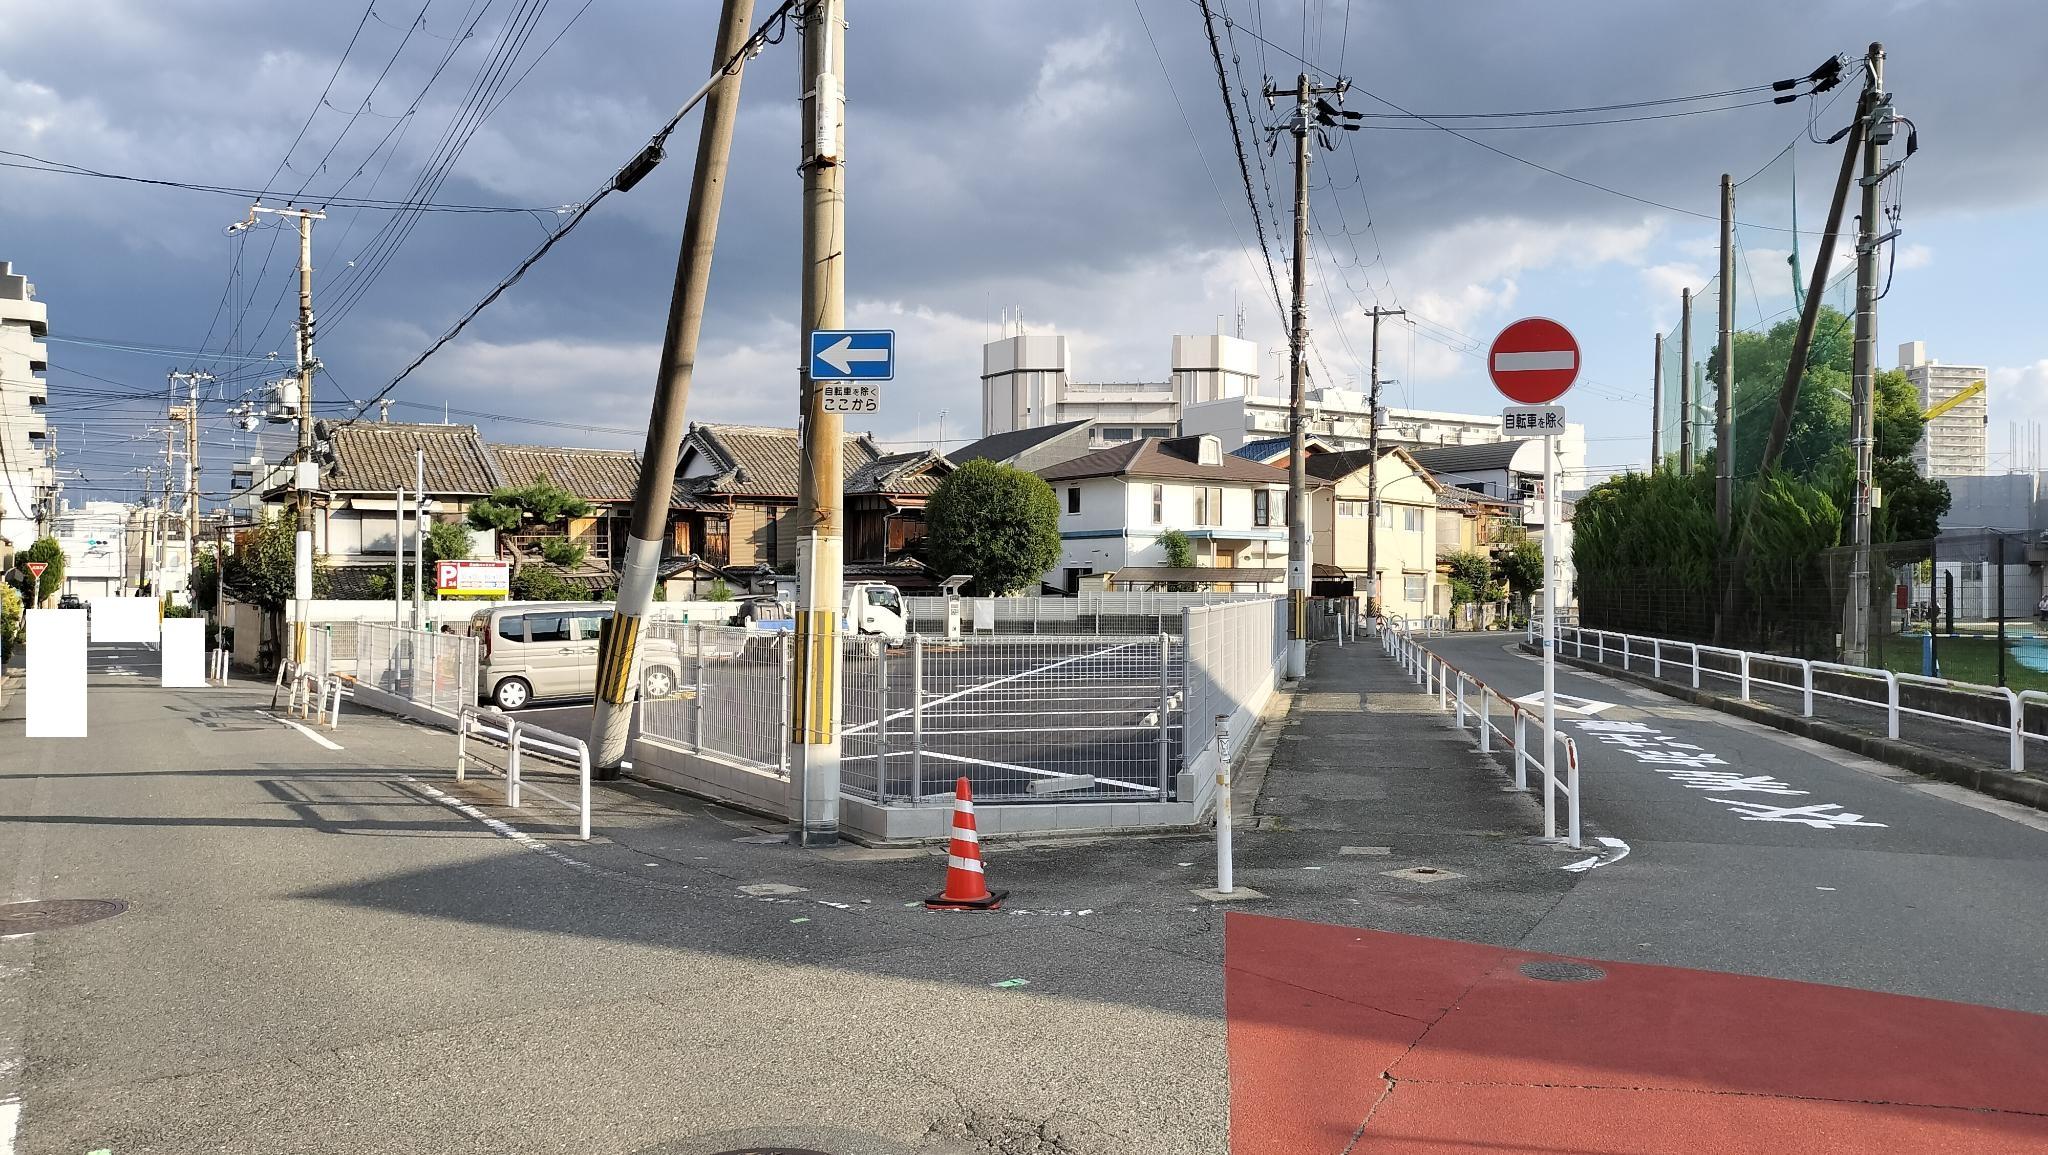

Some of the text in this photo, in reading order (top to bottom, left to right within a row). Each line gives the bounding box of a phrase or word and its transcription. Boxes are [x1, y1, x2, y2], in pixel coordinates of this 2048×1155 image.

[825, 387, 877, 396] 自転車を除く
[825, 399, 877, 411] ここから
[1505, 413, 1564, 429] 自転車を除く
[441, 565, 458, 587] P
